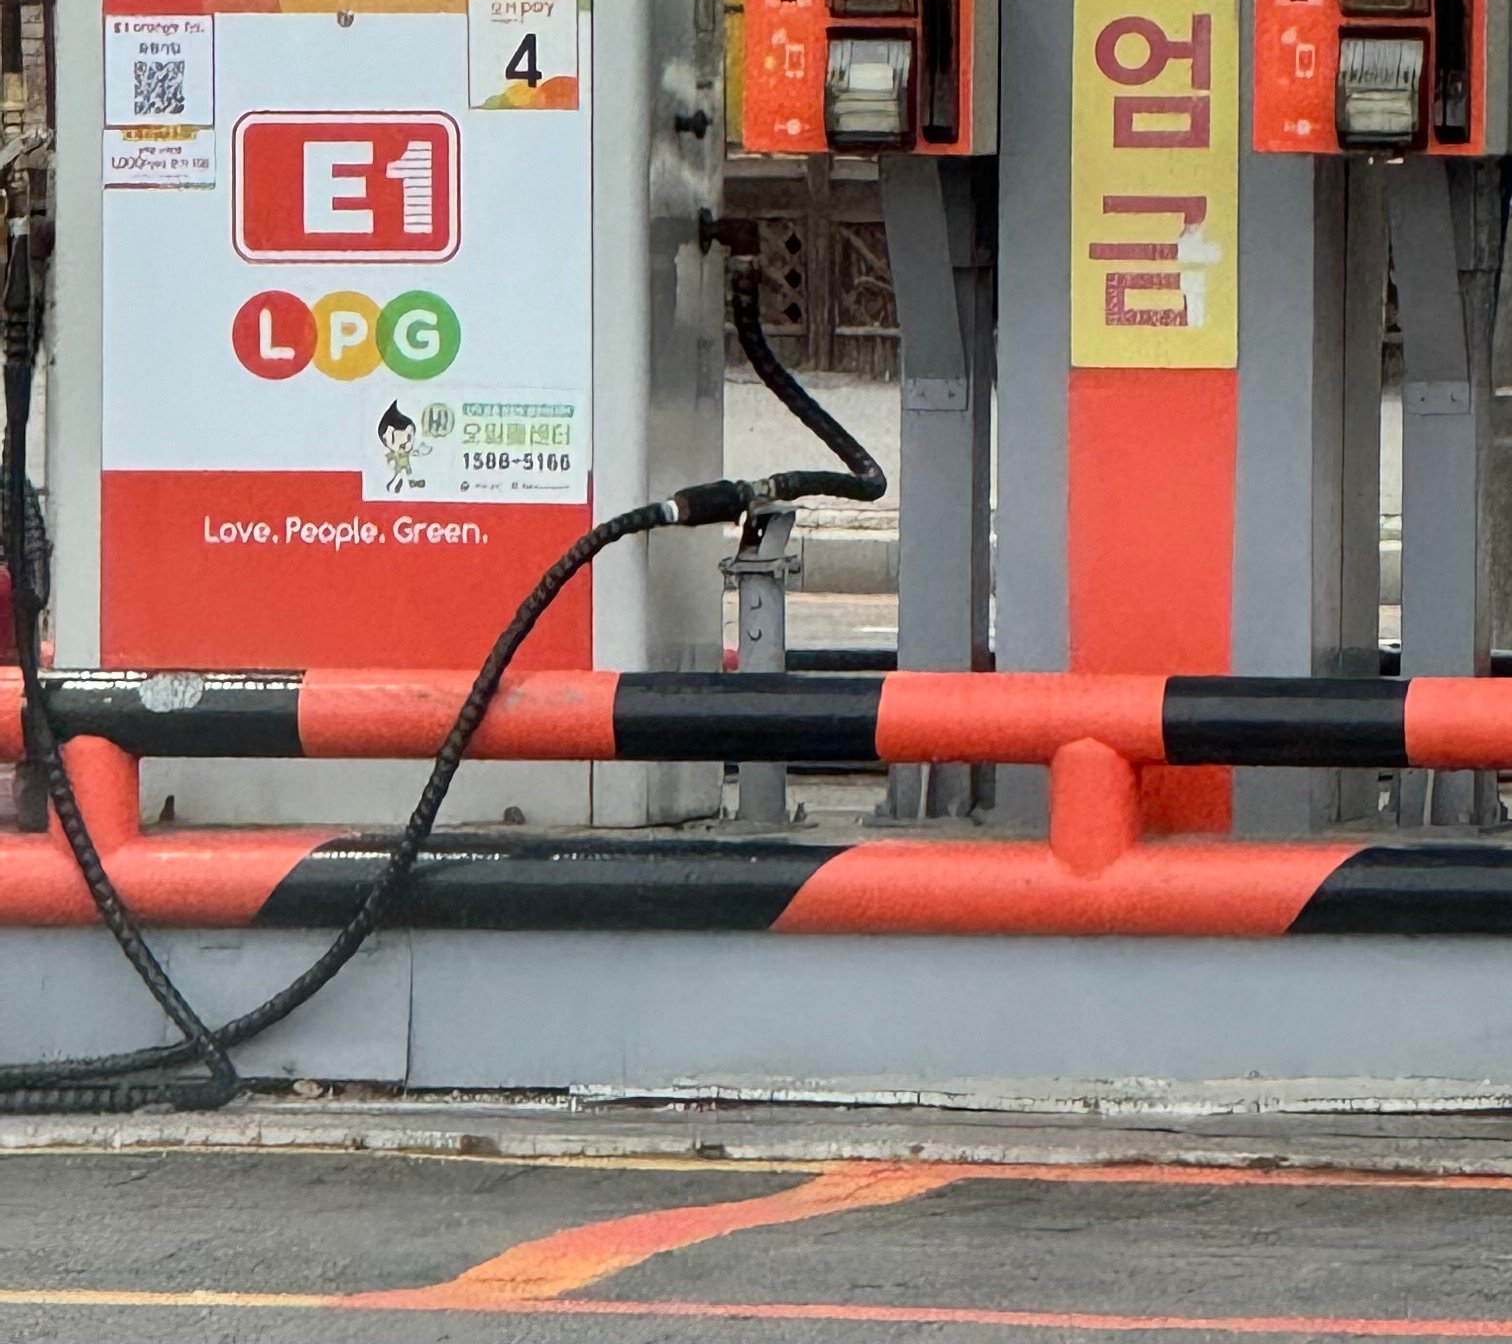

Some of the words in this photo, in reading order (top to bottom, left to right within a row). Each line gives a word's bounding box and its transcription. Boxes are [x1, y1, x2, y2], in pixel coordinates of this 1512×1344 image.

[505, 33, 542, 88] 4
[303, 141, 433, 234] E1
[258, 308, 440, 361] LPG
[203, 516, 278, 544] Love.
[285, 517, 386, 552] People.
[393, 516, 489, 544] Green.
